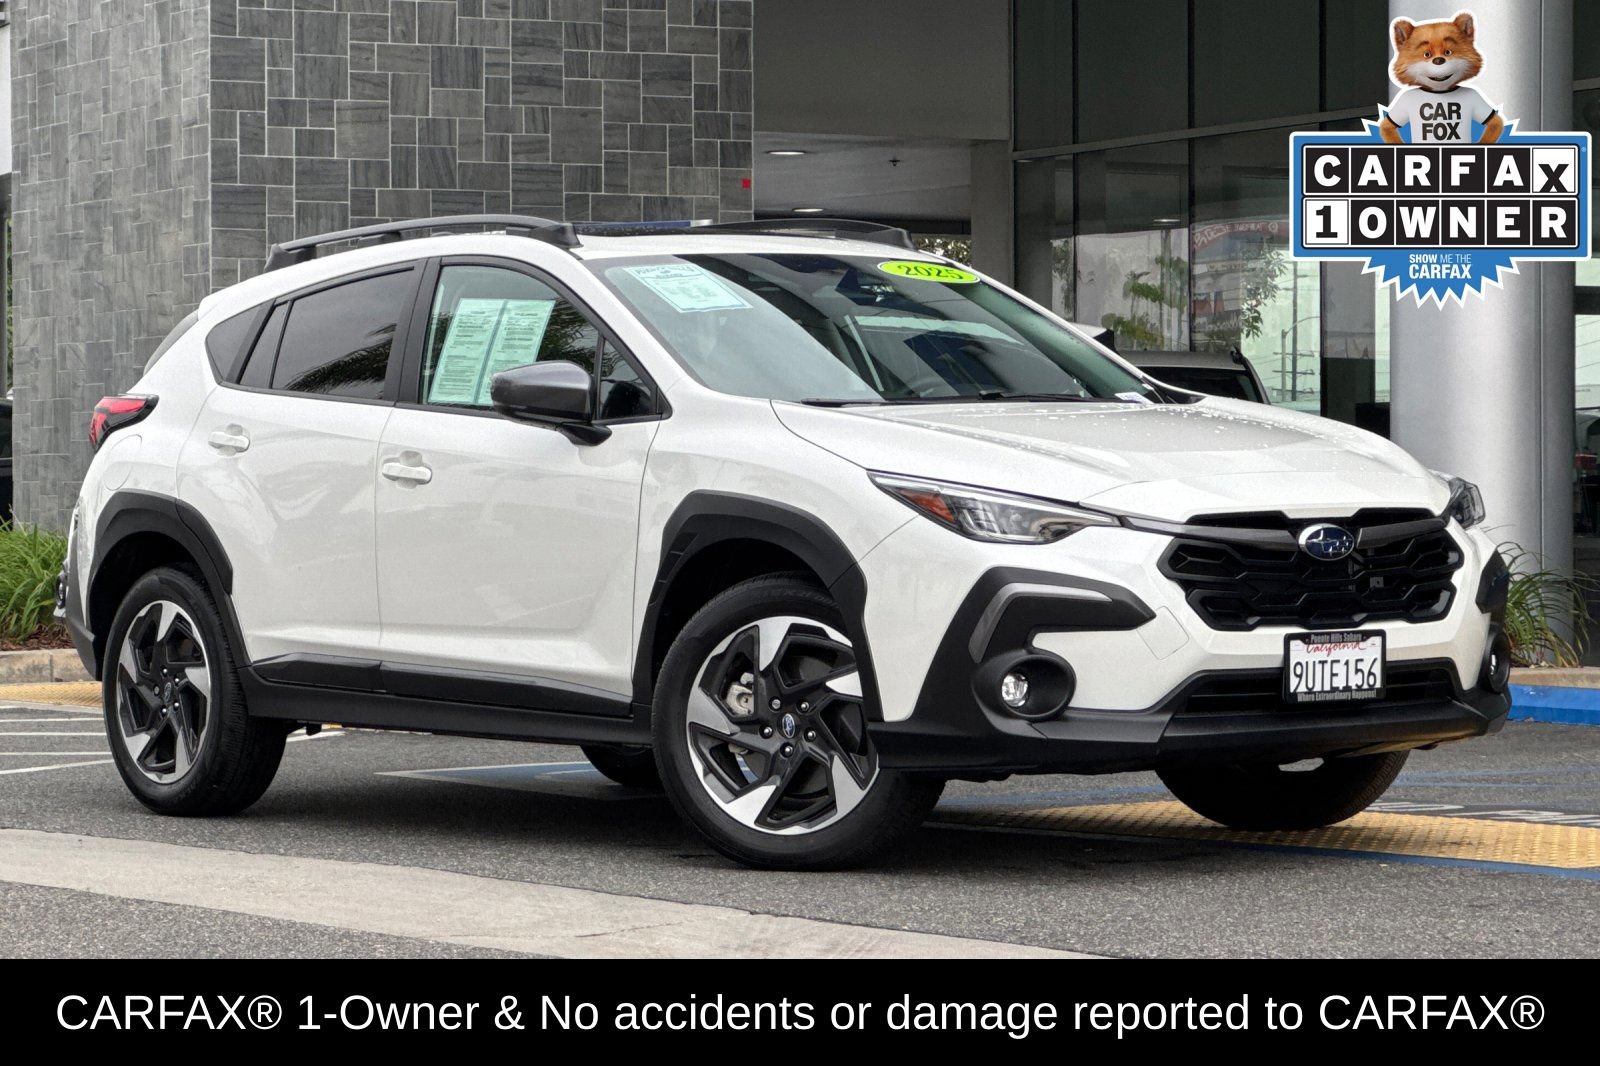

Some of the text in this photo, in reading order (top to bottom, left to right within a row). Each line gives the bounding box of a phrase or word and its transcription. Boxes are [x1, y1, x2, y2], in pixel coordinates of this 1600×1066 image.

[897, 264, 964, 280] 2025
[1306, 640, 1367, 657] California
[1293, 657, 1378, 692] 9UTE156
